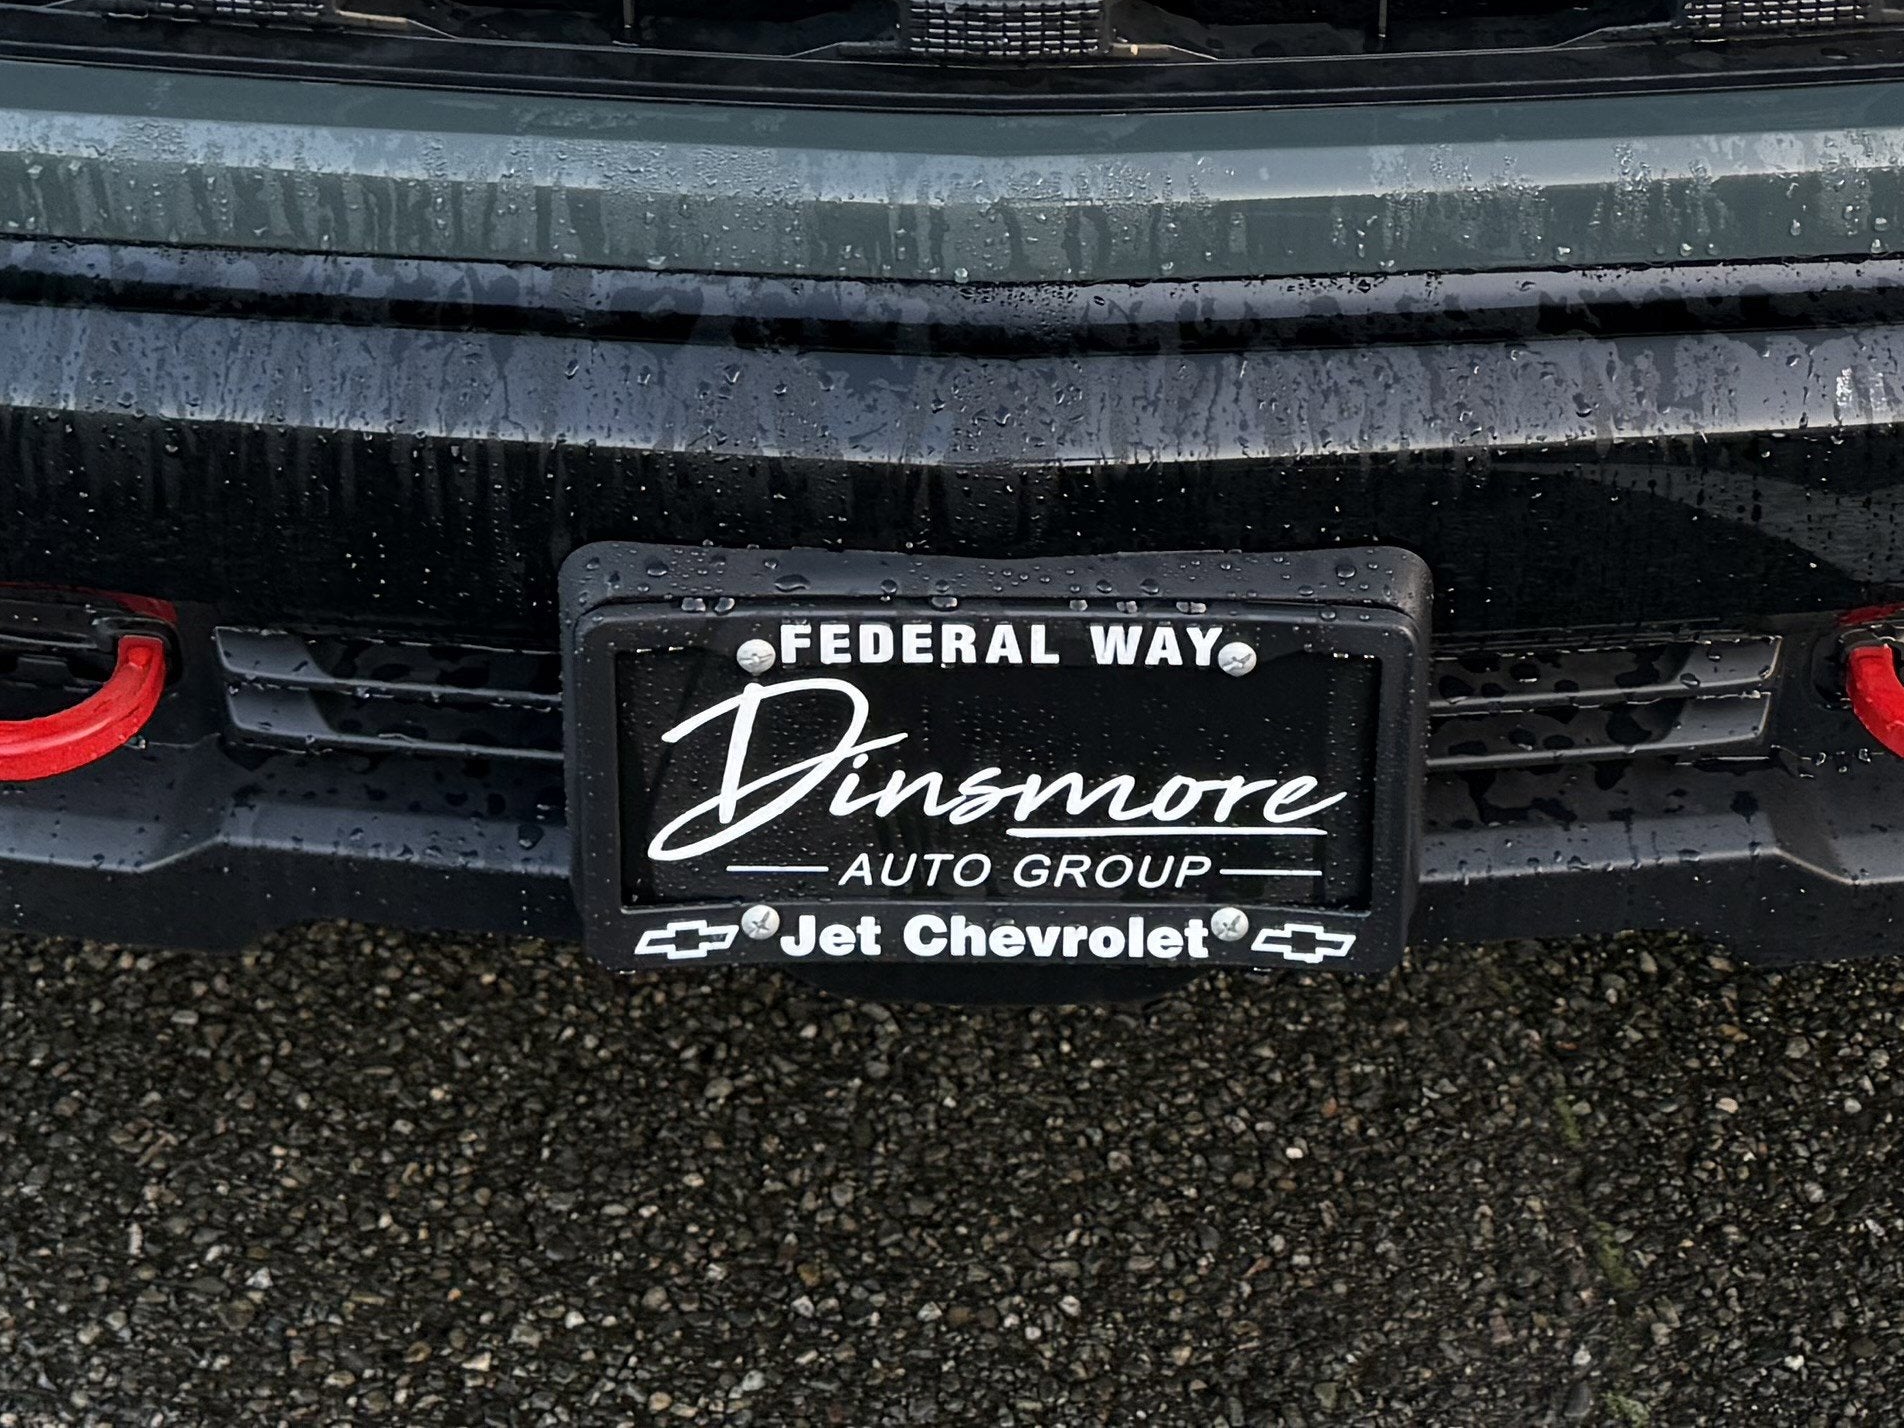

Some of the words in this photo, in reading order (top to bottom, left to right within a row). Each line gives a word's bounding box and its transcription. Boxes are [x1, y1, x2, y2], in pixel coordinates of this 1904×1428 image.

[780, 622, 1060, 666] FEDERAL
[1089, 624, 1225, 667] WAY
[647, 677, 1347, 861] Dinsmore
[838, 852, 992, 889] AUTO
[1013, 853, 1212, 889] GROUP
[779, 914, 882, 958] Jet
[903, 913, 1209, 960] Chevrolet
